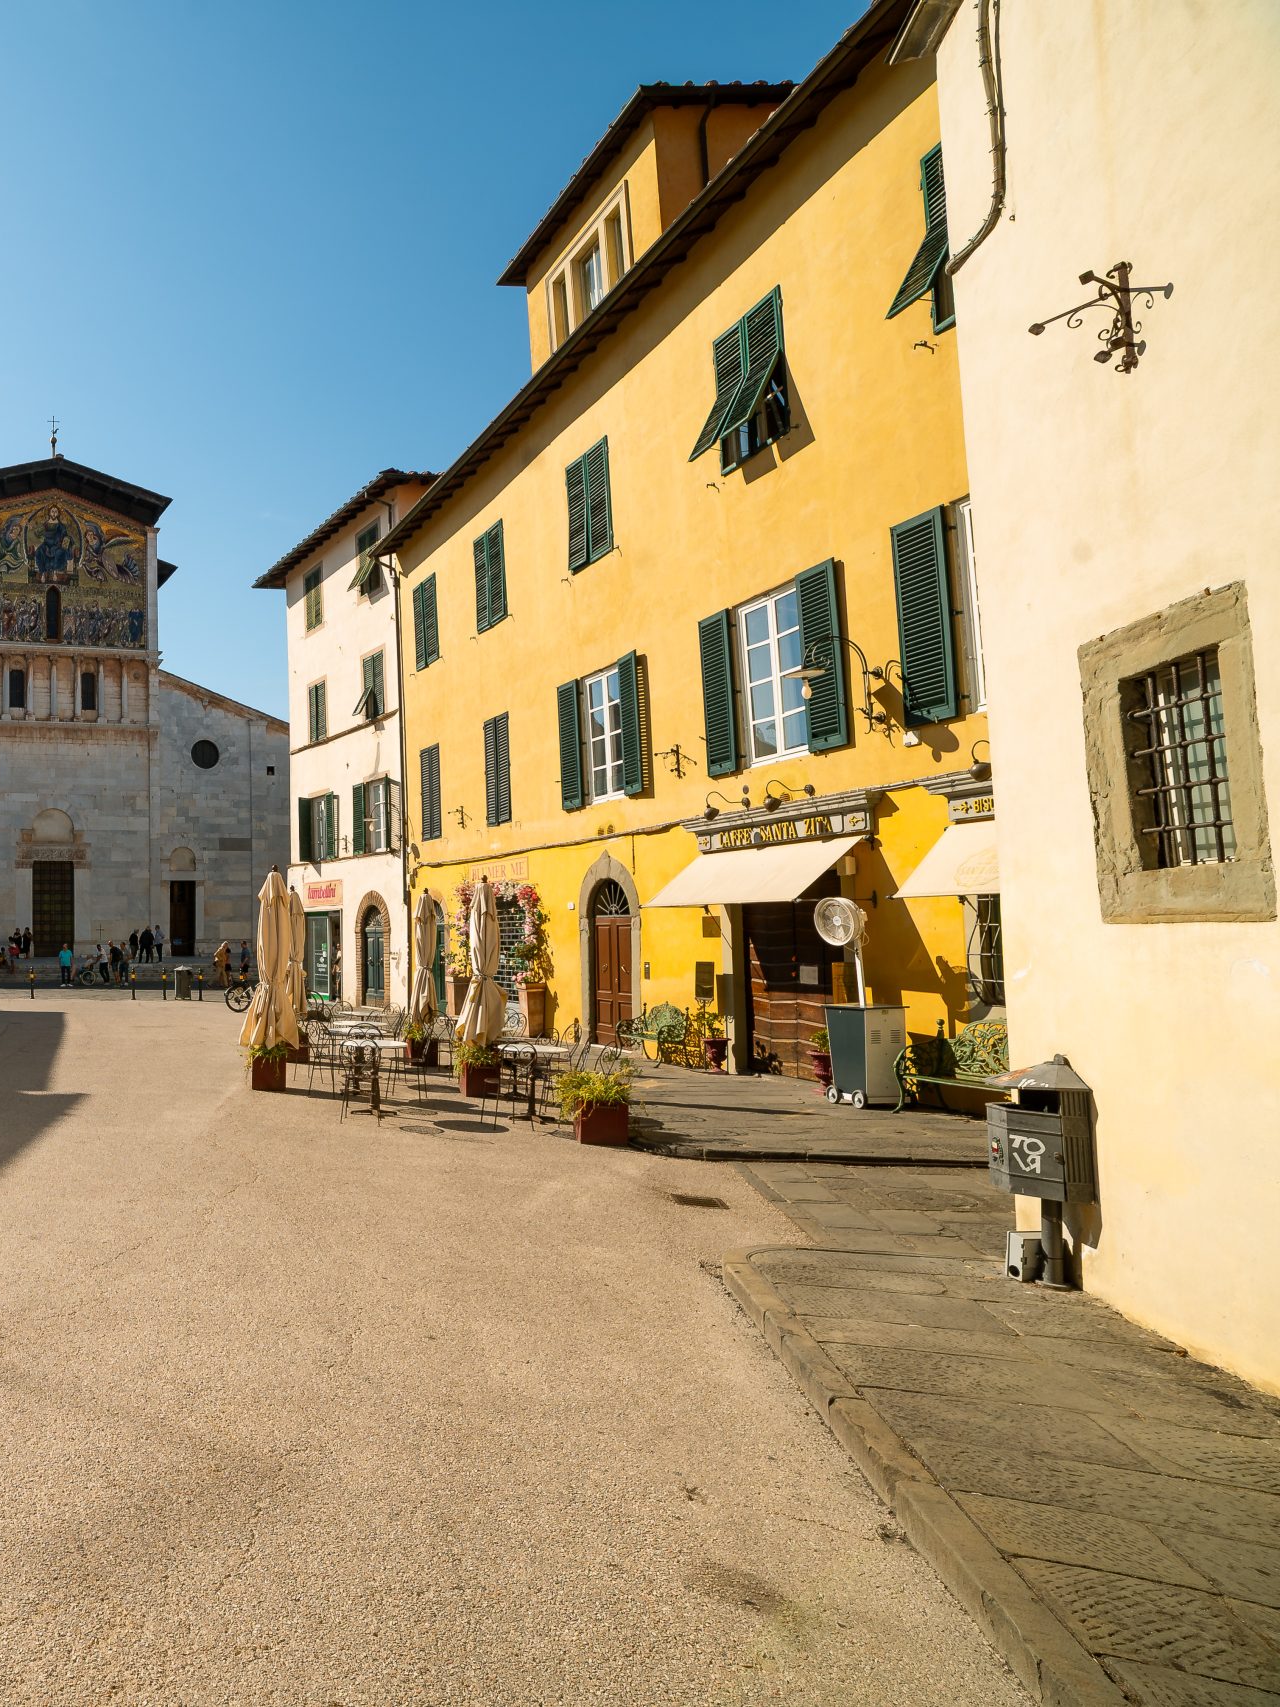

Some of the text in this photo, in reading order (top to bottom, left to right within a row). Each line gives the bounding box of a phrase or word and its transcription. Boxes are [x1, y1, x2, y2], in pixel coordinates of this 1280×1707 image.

[760, 821, 797, 842] SANTA
[804, 816, 832, 836] ZITA
[511, 862, 525, 876] ME
